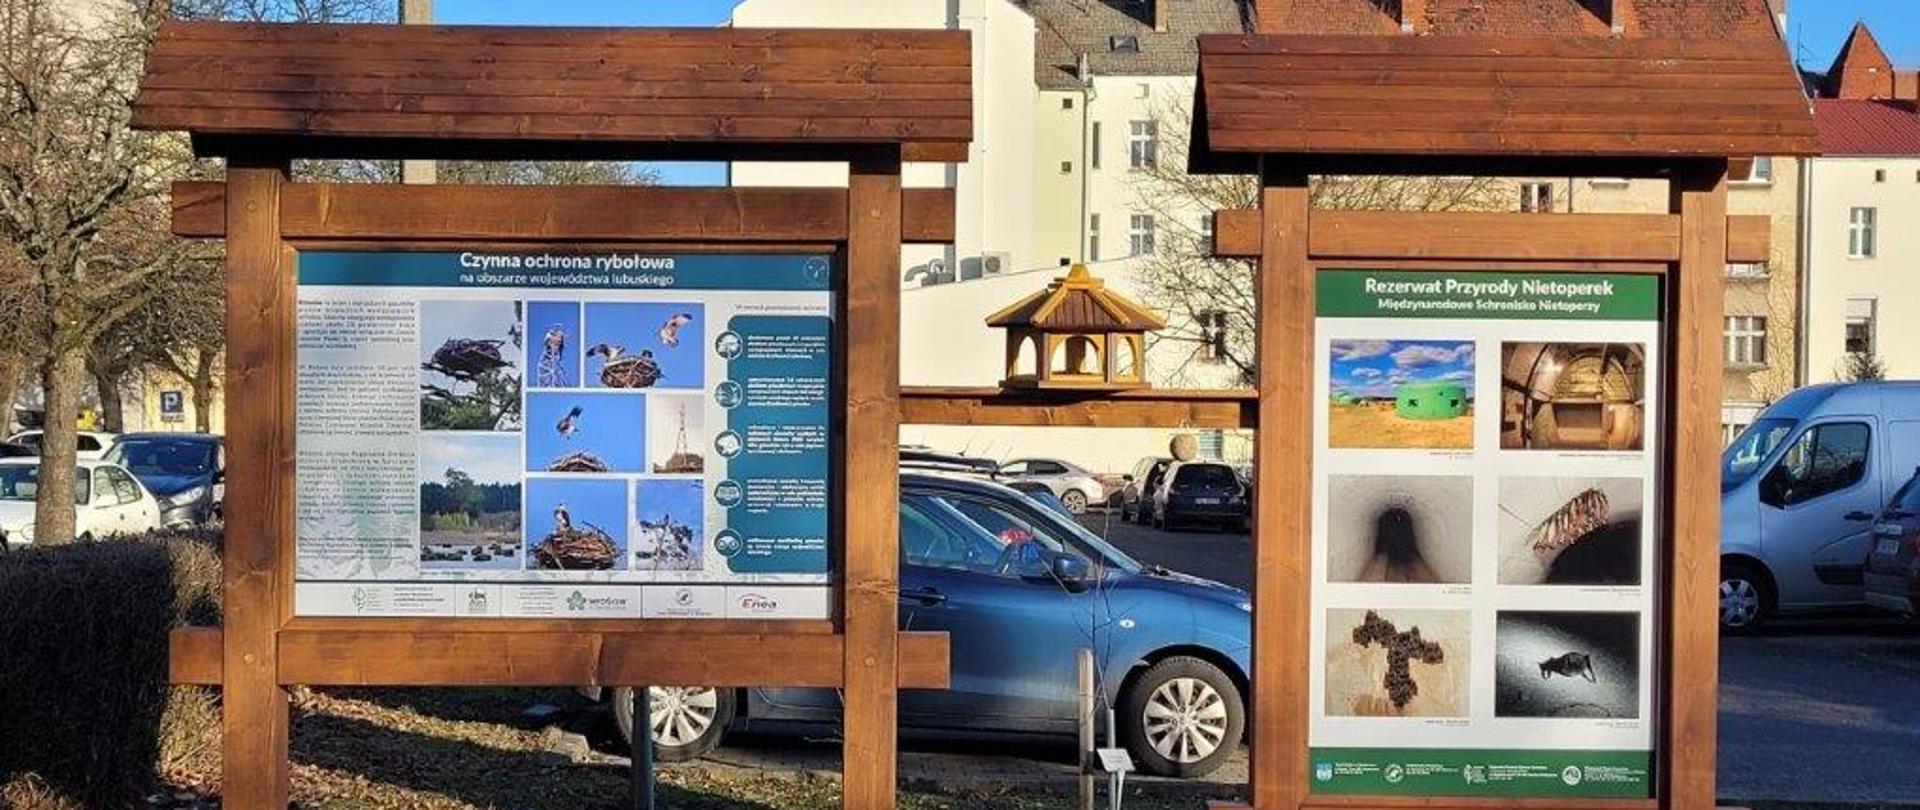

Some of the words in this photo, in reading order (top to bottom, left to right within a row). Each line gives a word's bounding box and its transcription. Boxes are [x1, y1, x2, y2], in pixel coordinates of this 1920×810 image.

[460, 252, 521, 270] Czynna
[524, 253, 591, 269] ochrona
[596, 253, 675, 272] rybołowa
[459, 274, 474, 284] na
[476, 271, 528, 285] obszarze
[530, 271, 610, 286] województwa
[612, 273, 675, 287] lubuskiego
[1365, 278, 1442, 294] Rezerwat
[1445, 278, 1519, 298] Przyrody
[1522, 280, 1614, 298] Nietoperek
[1378, 297, 1474, 312] Międzynarodowe
[1476, 298, 1537, 311] Schronisko
[1538, 299, 1600, 313] Nietoperzy
[164, 393, 178, 410] P
[742, 598, 777, 609] Enea
